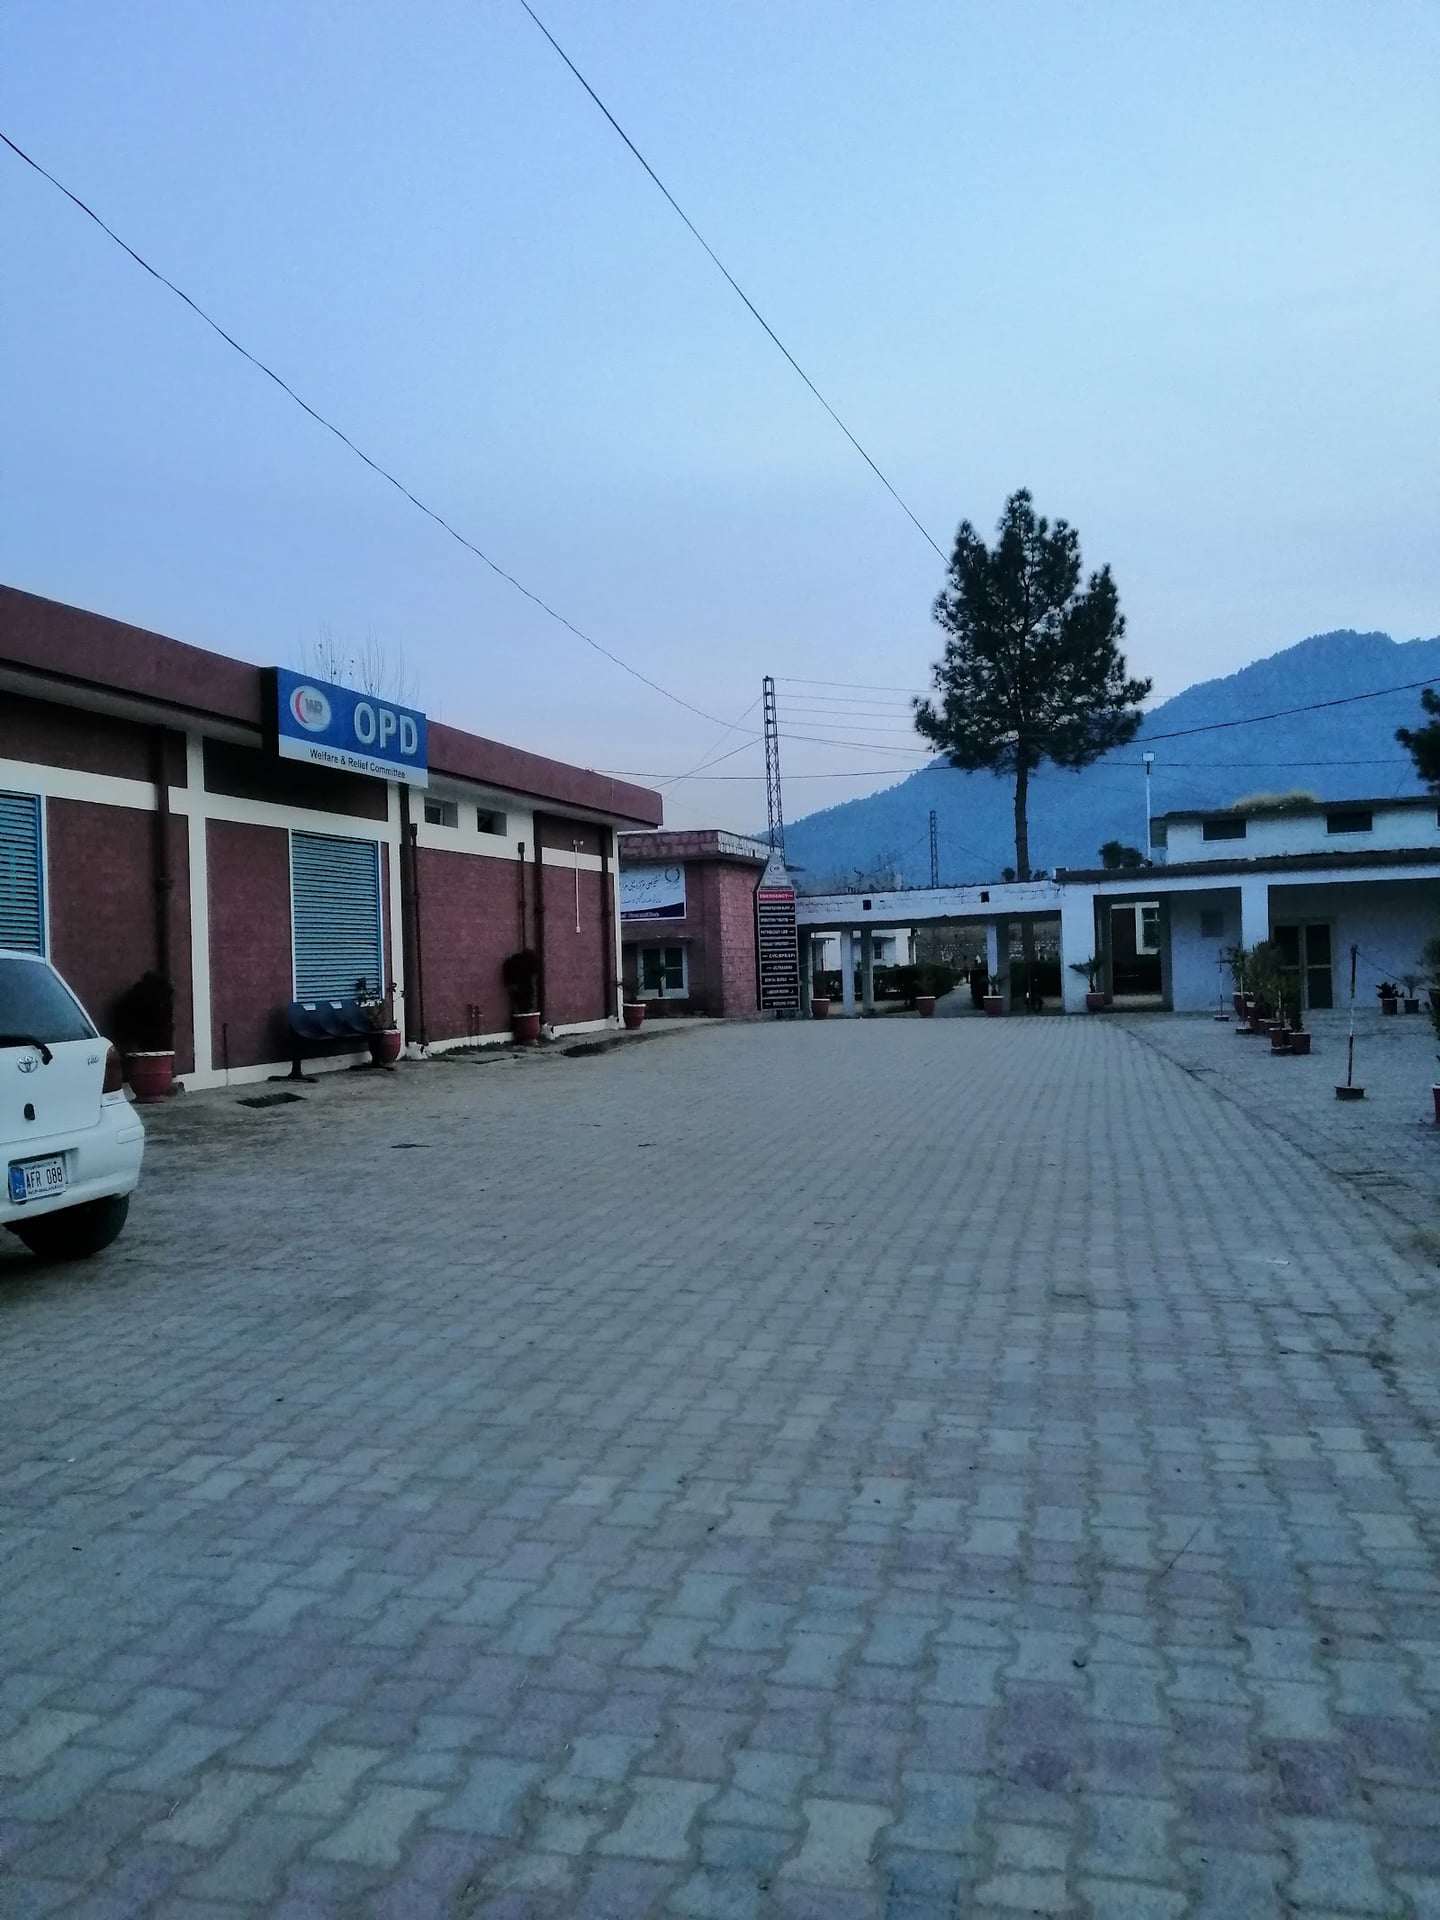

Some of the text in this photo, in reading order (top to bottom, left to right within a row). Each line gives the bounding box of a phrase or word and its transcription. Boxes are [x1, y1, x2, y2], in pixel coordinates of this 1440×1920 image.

[354, 701, 418, 755] OPD
[310, 748, 406, 779] Welfare & Relief Committee
[26, 1166, 63, 1189] AFR 088
